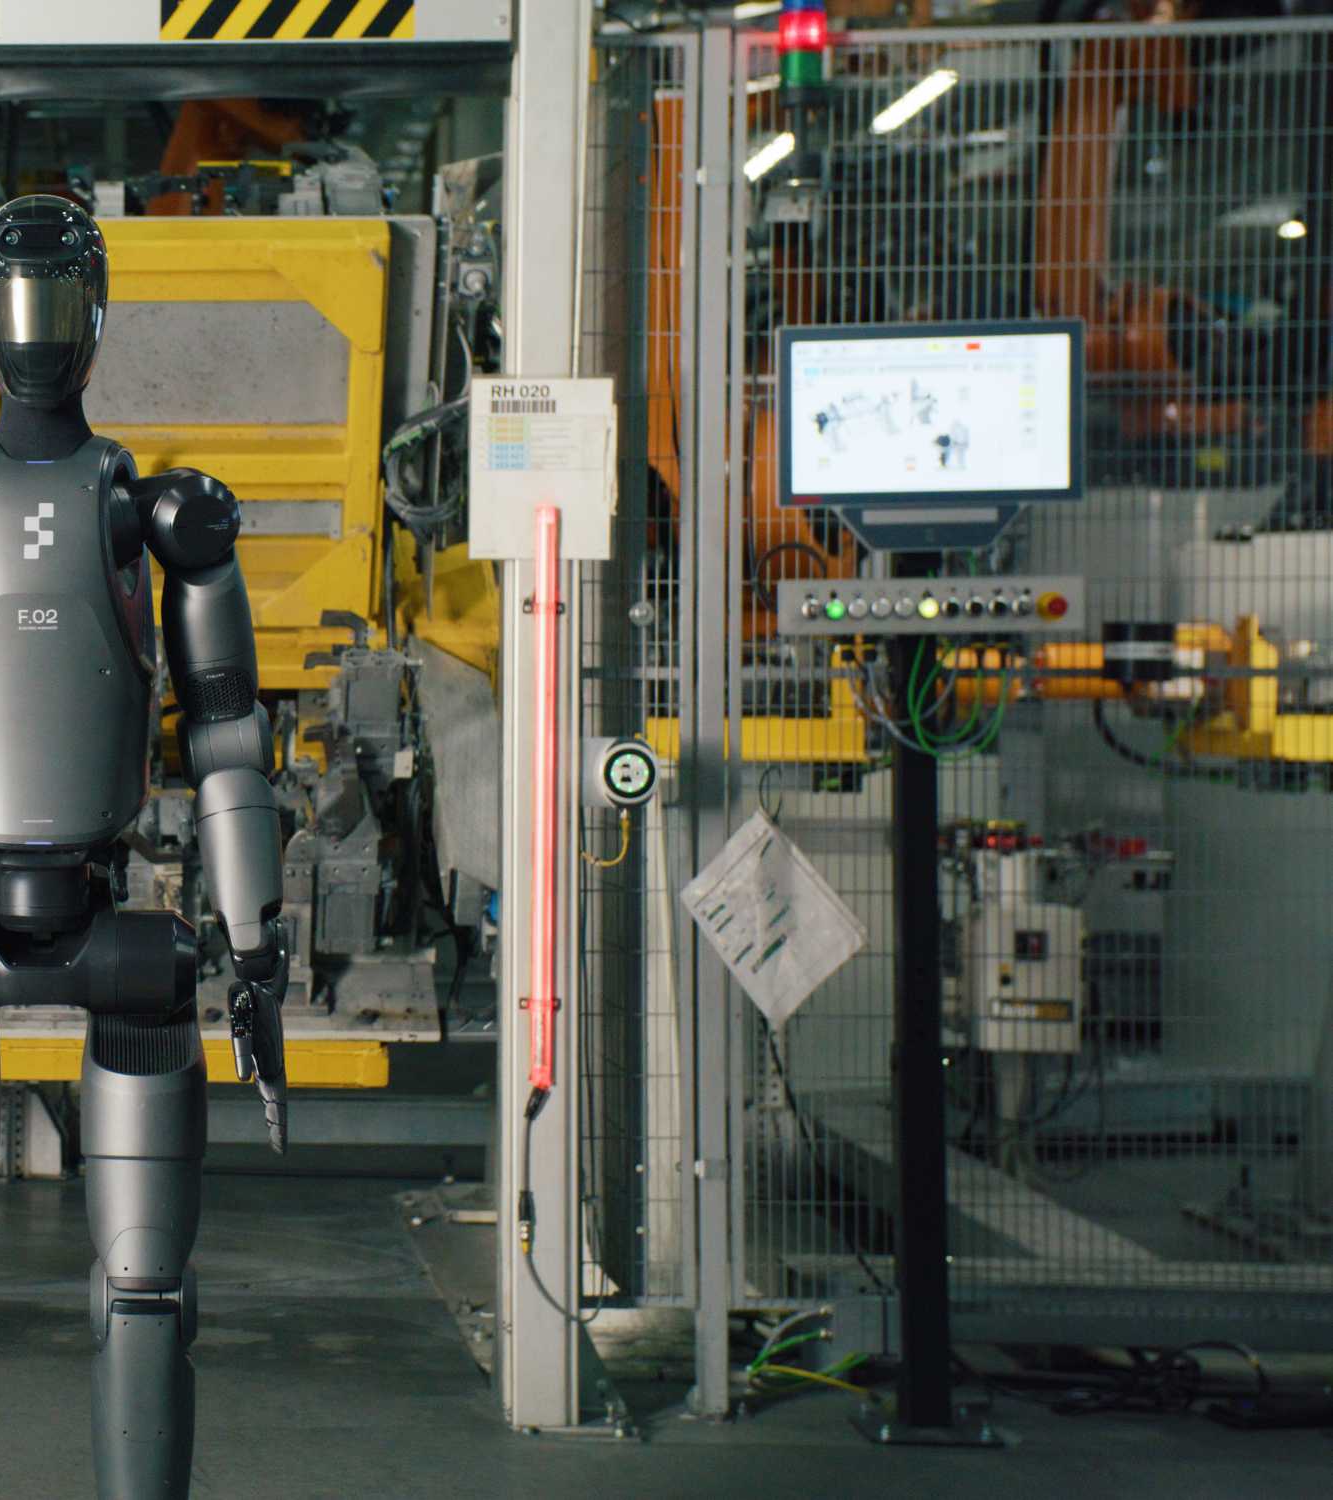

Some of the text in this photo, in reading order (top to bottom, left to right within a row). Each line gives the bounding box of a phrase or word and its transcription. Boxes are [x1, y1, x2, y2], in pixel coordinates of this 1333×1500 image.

[490, 384, 551, 398] RH 020
[18, 609, 58, 624] F.02
